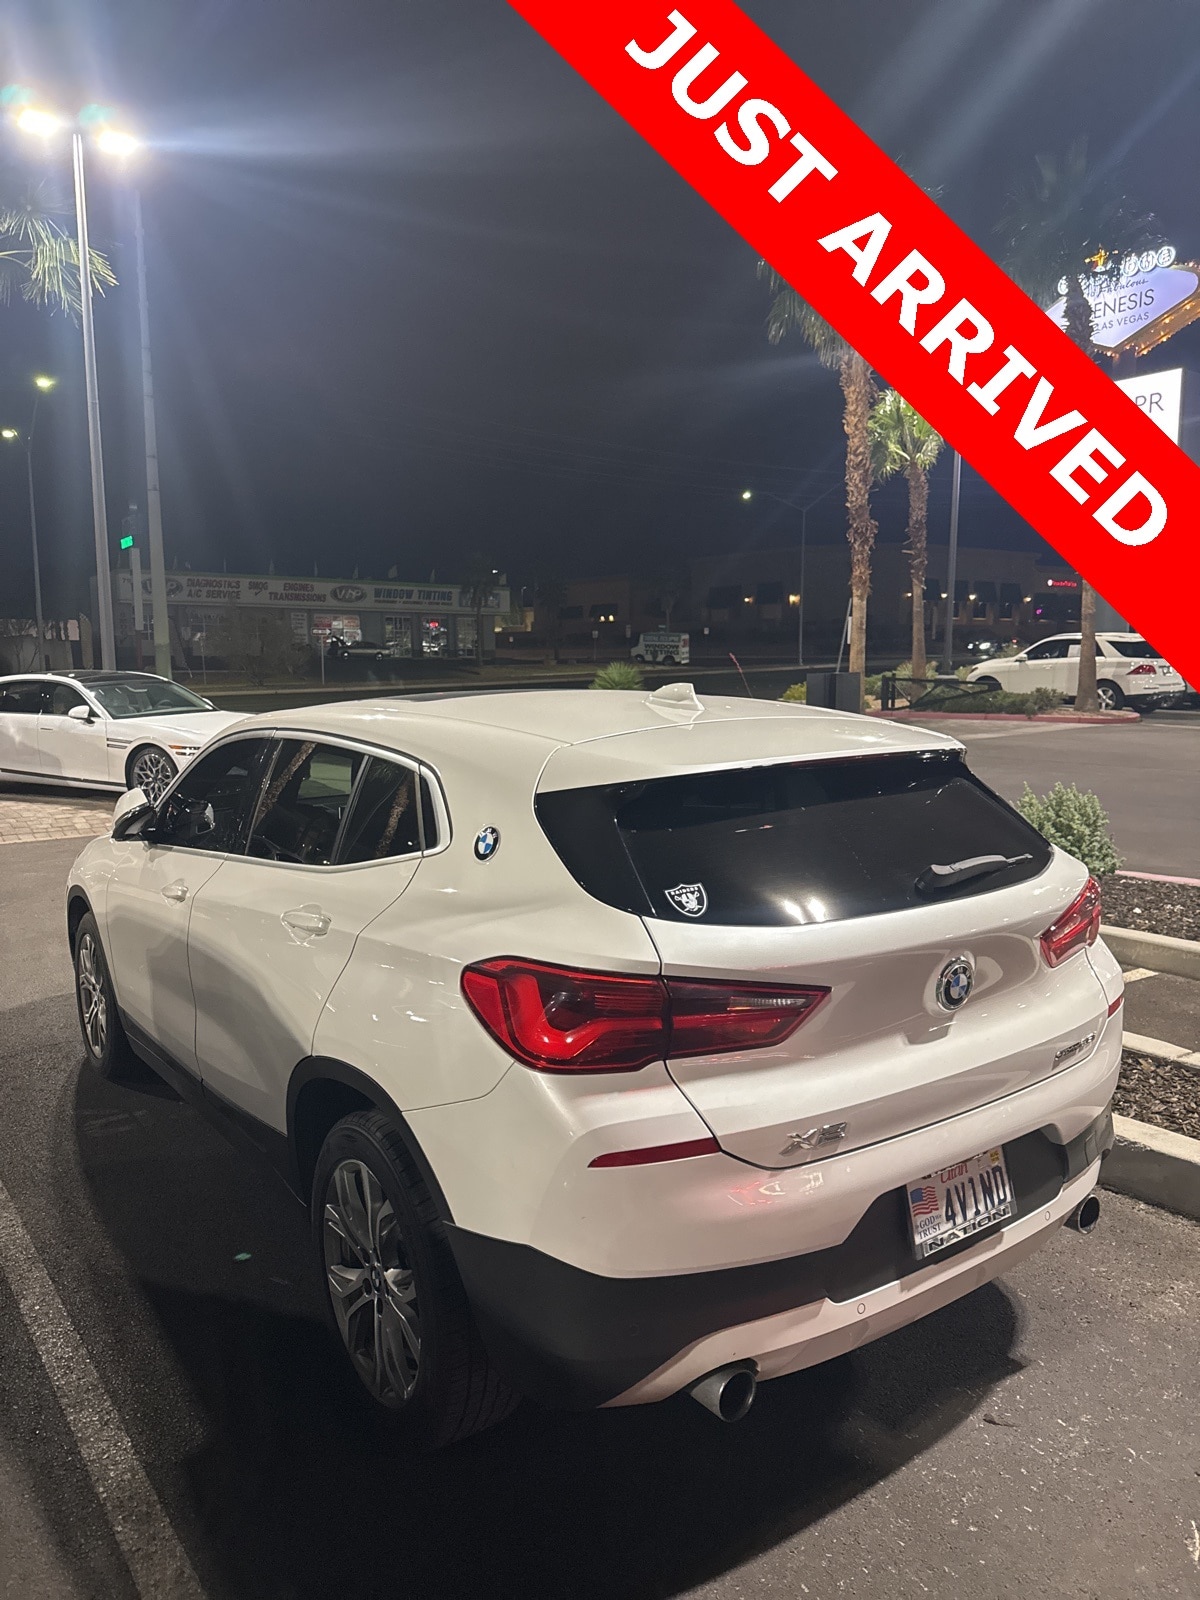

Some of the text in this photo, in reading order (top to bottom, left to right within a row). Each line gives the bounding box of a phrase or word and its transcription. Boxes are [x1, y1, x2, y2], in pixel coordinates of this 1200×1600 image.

[1094, 288, 1155, 319] ENESIS
[1117, 311, 1150, 326] VEGAS
[186, 578, 241, 590] DIAGNOSTICS
[248, 581, 268, 590] SMOG
[283, 583, 315, 592] ENGINES
[187, 589, 241, 600] A/C SERVICE
[269, 592, 327, 602] TRANSMISSIONS
[374, 587, 414, 600] WINDOW
[417, 589, 453, 601] TINTING
[779, 1121, 847, 1157] X2
[919, 1215, 935, 1229] GOD
[917, 1222, 941, 1239] TRUST
[928, 1207, 1007, 1252] NATION
